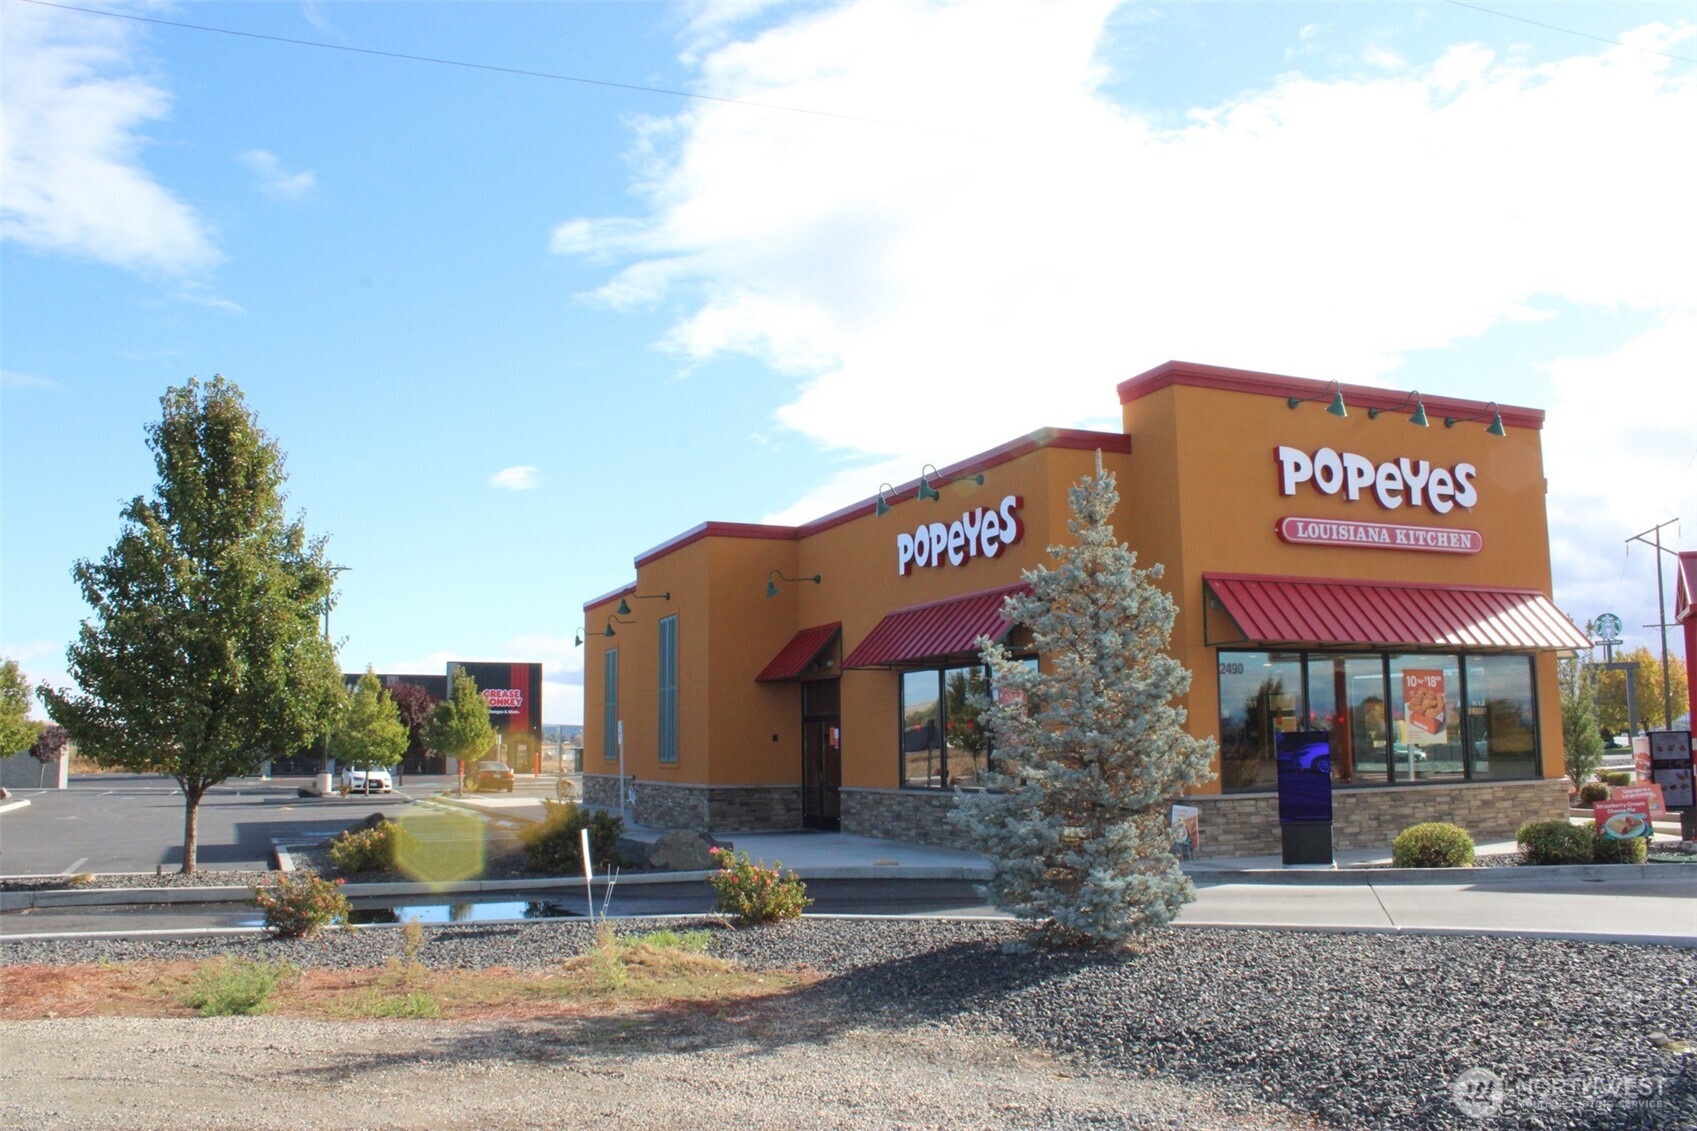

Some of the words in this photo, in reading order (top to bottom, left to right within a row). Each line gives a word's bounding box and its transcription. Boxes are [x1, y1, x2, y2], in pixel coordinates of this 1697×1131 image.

[1296, 521, 1391, 544] LOUISIANA
[1394, 528, 1472, 549] KITCHEN
[1219, 662, 1244, 675] 2490
[1406, 675, 1417, 687] 10
[483, 689, 521, 698] GREASE
[487, 697, 523, 707] ONKEY
[1596, 802, 1626, 810] Strawberry
